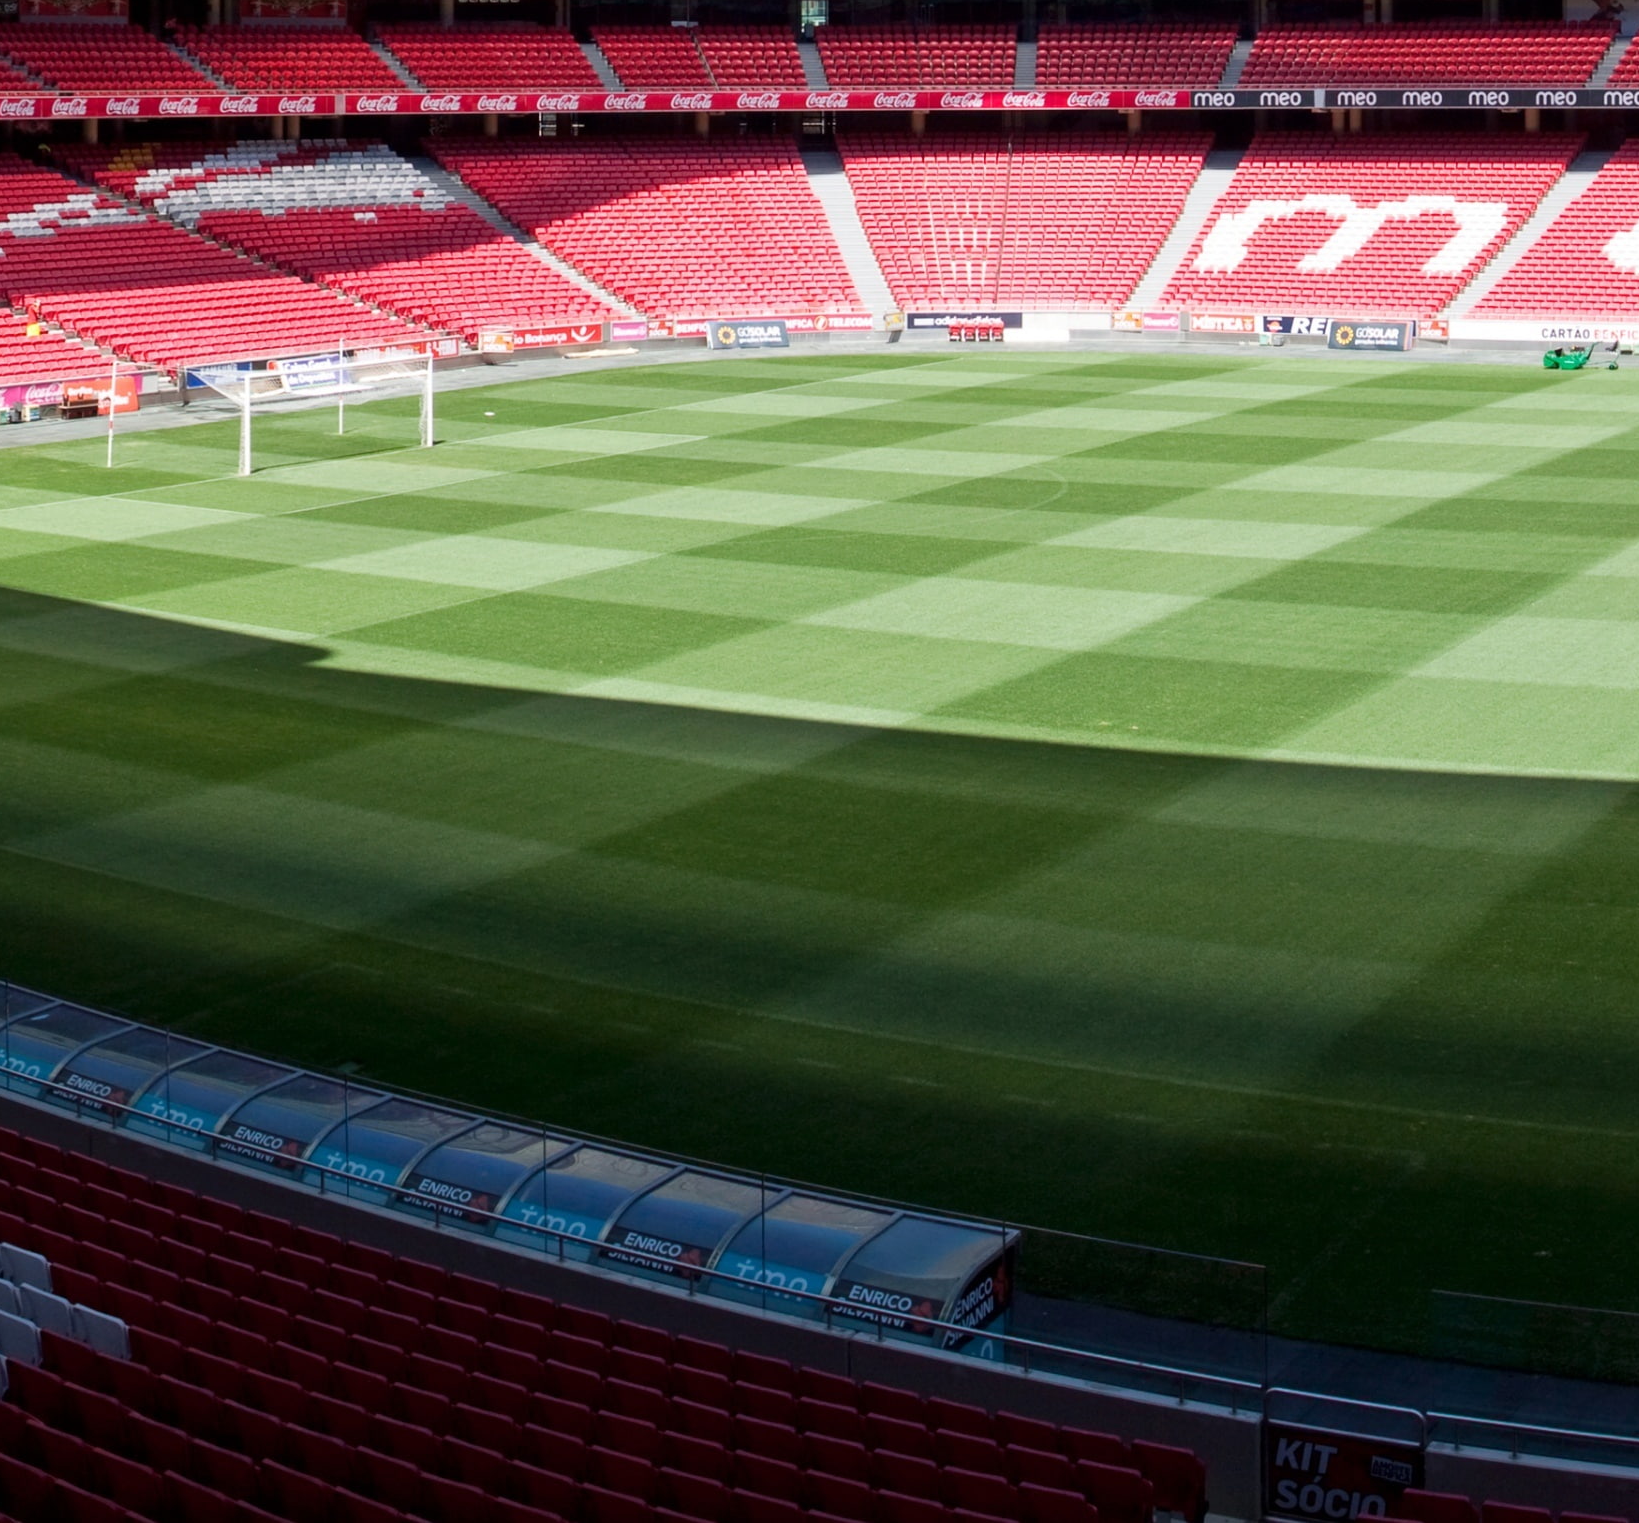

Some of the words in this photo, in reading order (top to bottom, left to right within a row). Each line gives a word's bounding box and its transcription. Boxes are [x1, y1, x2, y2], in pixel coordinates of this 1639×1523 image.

[670, 93, 712, 109] Coca-Cola
[1536, 92, 1576, 105] meo
[828, 316, 873, 328] TELECOM
[1541, 326, 1590, 340] CARTÃO
[235, 1124, 283, 1151] ENRICO
[326, 1150, 386, 1182] tmn
[625, 1231, 682, 1258] ENRICO
[735, 1259, 808, 1303] tmn
[952, 1276, 994, 1323] ENRICO
[1274, 1437, 1339, 1475] KIT
